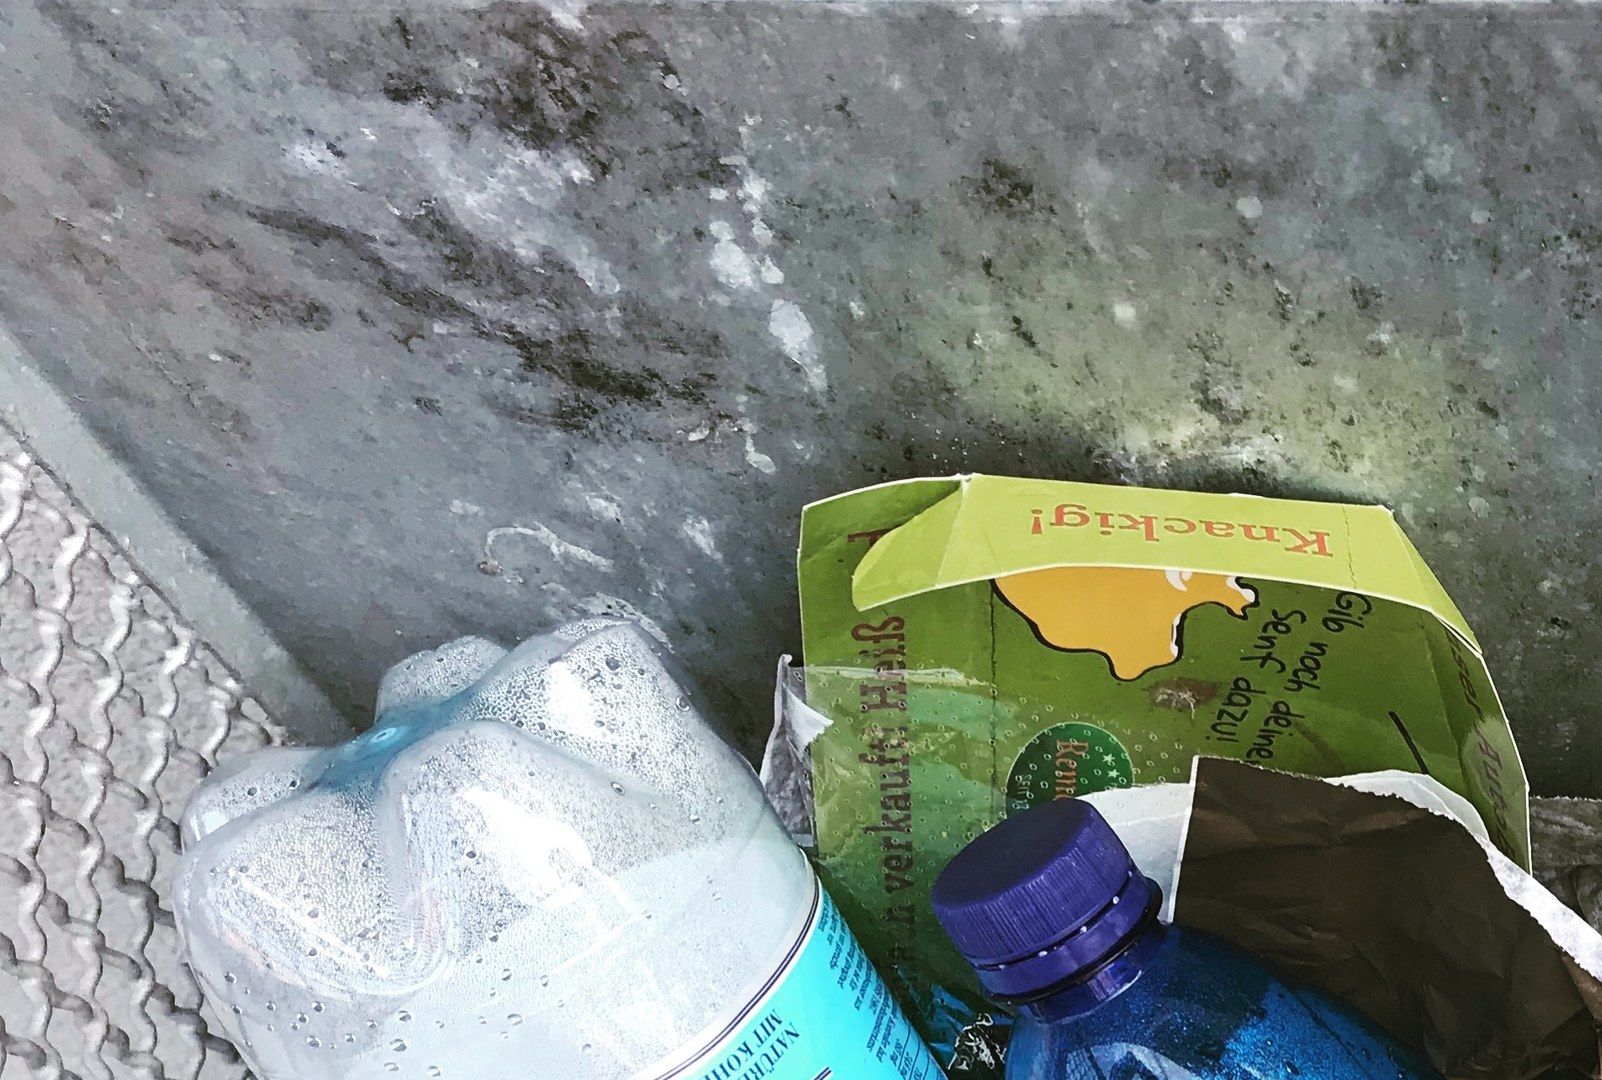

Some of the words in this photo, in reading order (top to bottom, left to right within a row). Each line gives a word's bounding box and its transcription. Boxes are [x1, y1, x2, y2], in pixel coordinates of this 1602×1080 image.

[1030, 503, 1335, 558] Knackig!
[1321, 591, 1371, 633] Gib
[851, 616, 907, 712] Heiß
[1240, 608, 1306, 673] Senf
[1283, 641, 1328, 692] noch
[1204, 676, 1265, 742] dazu!
[747, 1009, 781, 1048] MIT
